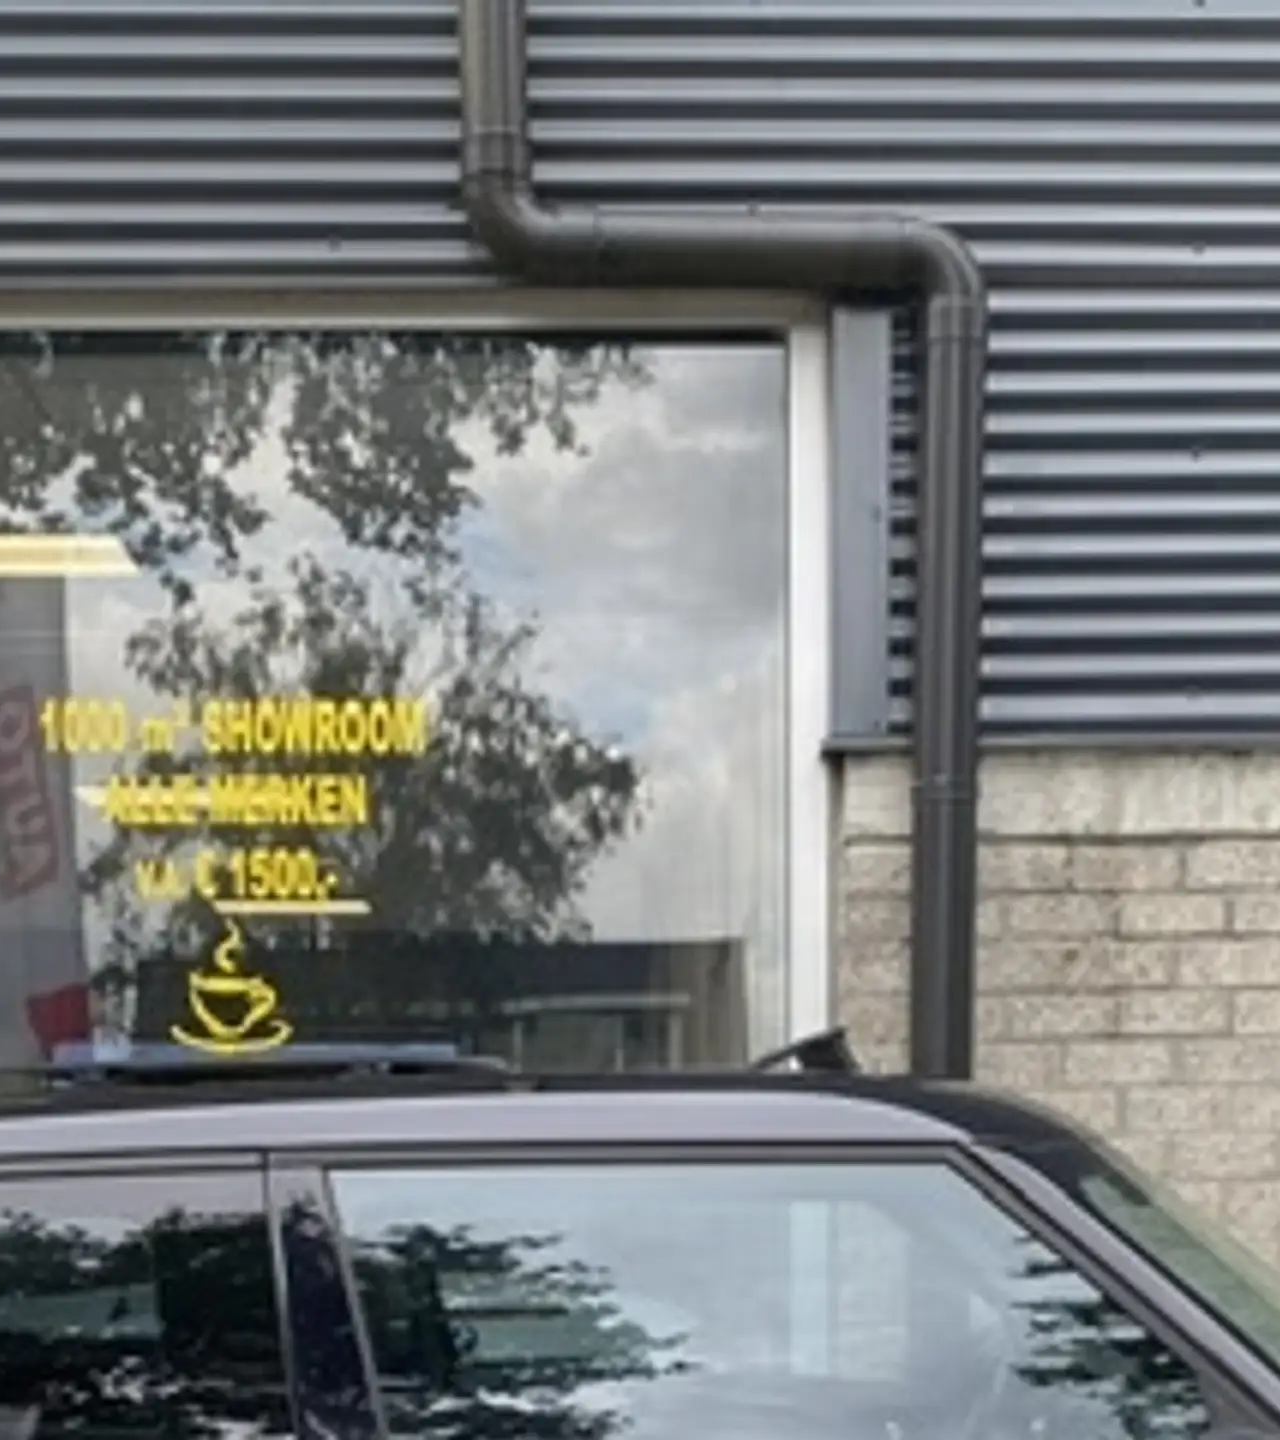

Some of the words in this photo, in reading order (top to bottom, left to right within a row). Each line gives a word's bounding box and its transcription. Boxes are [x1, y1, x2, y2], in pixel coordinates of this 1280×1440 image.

[40, 699, 126, 754] 1000
[202, 697, 428, 755] SHOWROOM
[105, 774, 197, 825] ALLE
[210, 774, 369, 825] MERKEN
